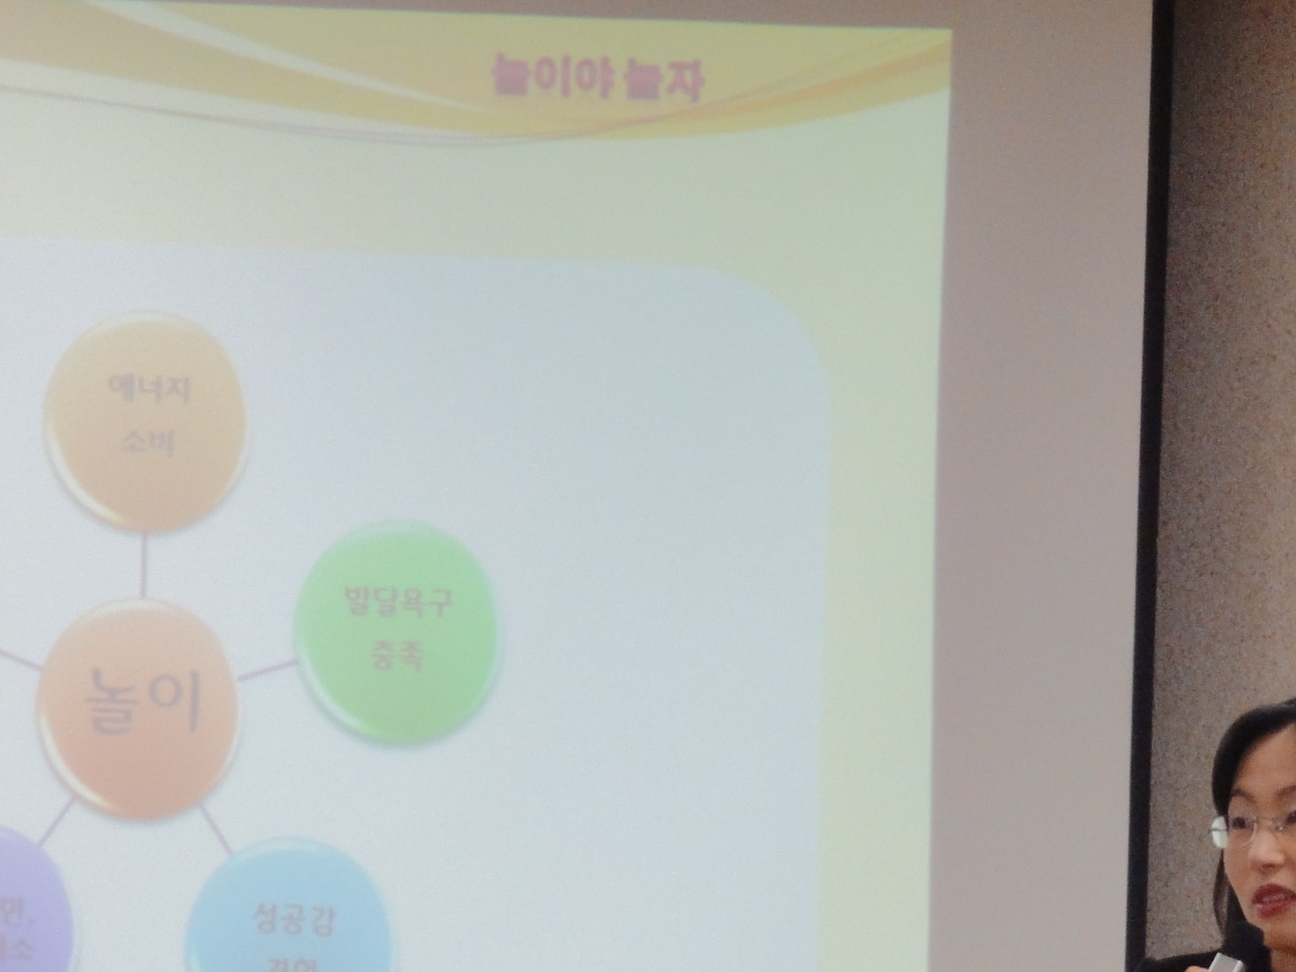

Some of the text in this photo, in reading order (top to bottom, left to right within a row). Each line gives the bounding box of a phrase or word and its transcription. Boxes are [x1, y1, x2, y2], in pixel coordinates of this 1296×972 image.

[491, 52, 706, 103] 놀이야 놀자
[120, 430, 175, 458] 소비
[344, 585, 455, 620] 발달욕구
[370, 639, 425, 673] 충족
[84, 668, 201, 736] 놀이
[252, 901, 337, 937] 성공감
